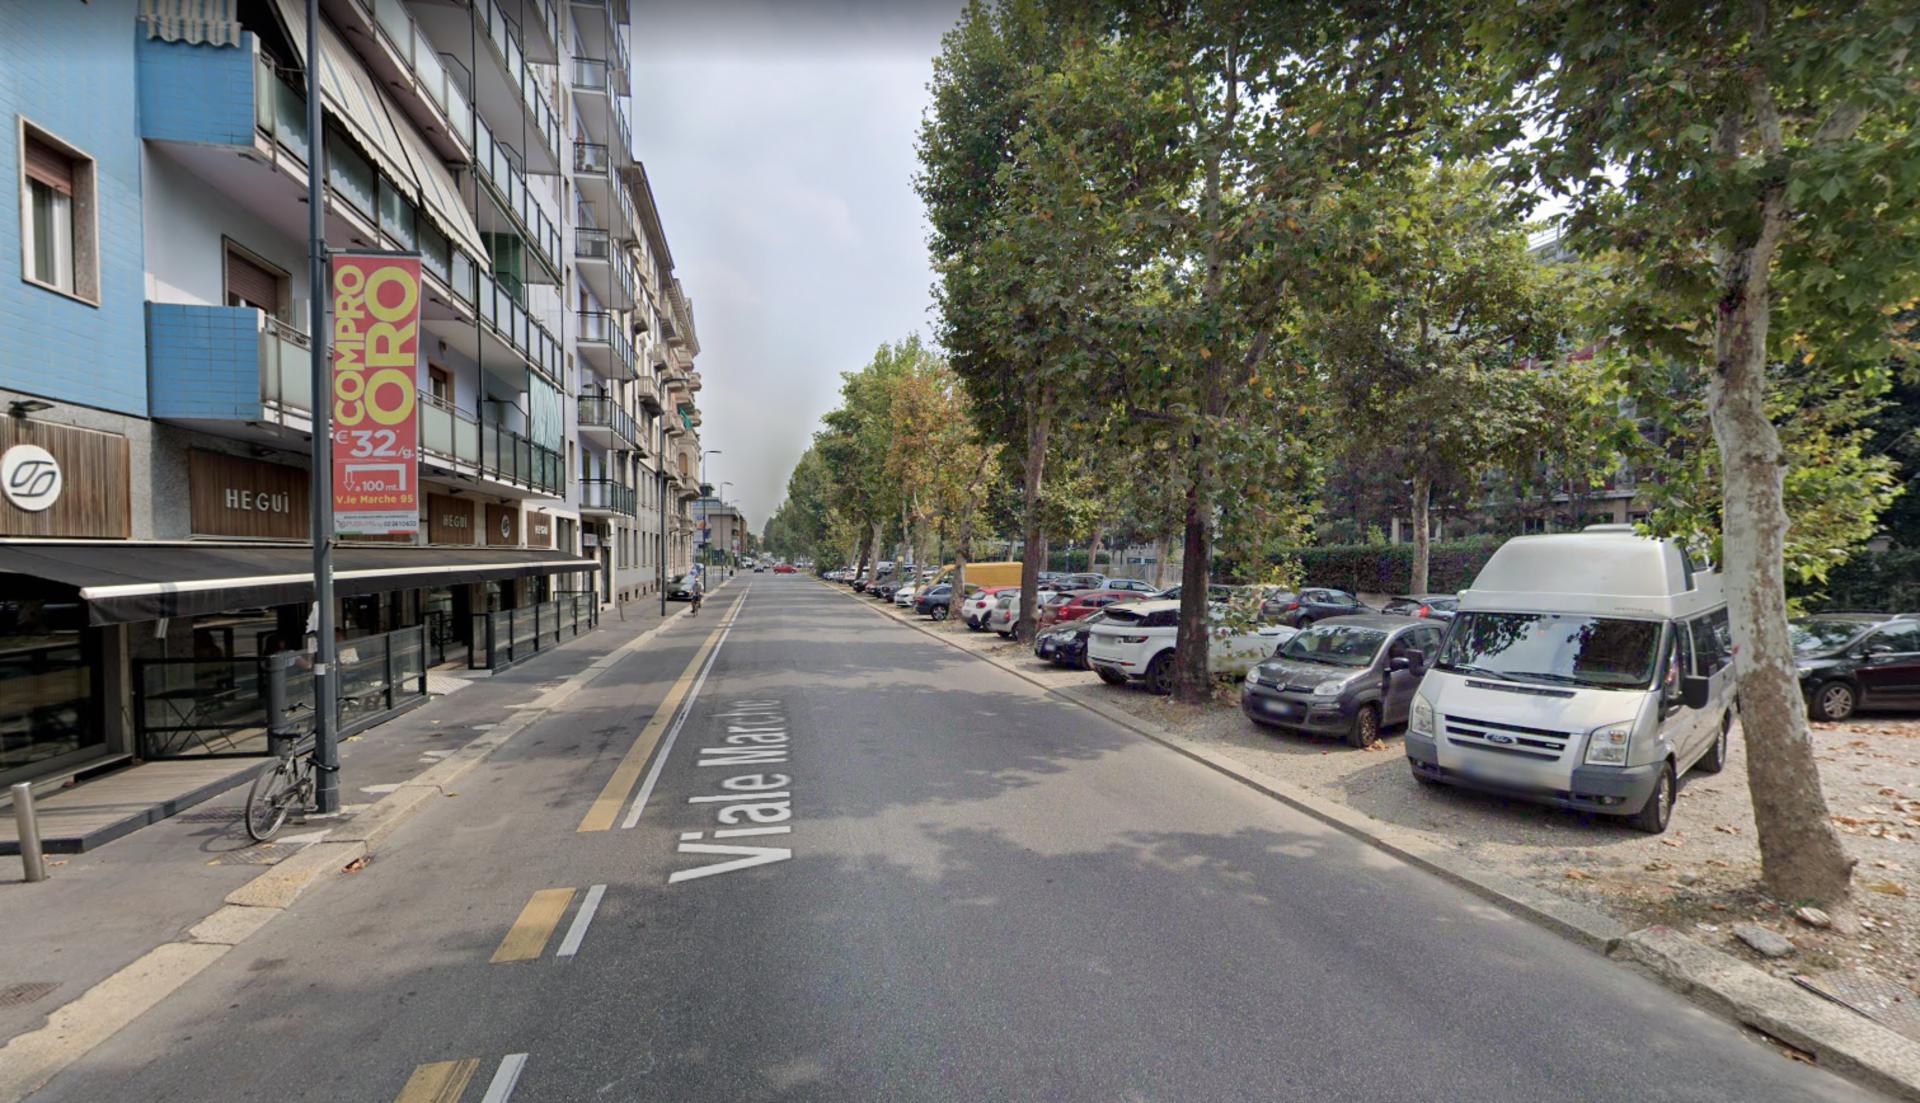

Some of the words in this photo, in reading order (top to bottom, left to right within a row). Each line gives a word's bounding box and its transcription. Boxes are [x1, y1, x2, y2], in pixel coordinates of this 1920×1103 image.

[335, 265, 364, 426] COMPRO
[364, 266, 417, 425] ORO
[360, 495, 397, 504] Marche
[400, 495, 414, 503] 95
[362, 481, 384, 491] 100
